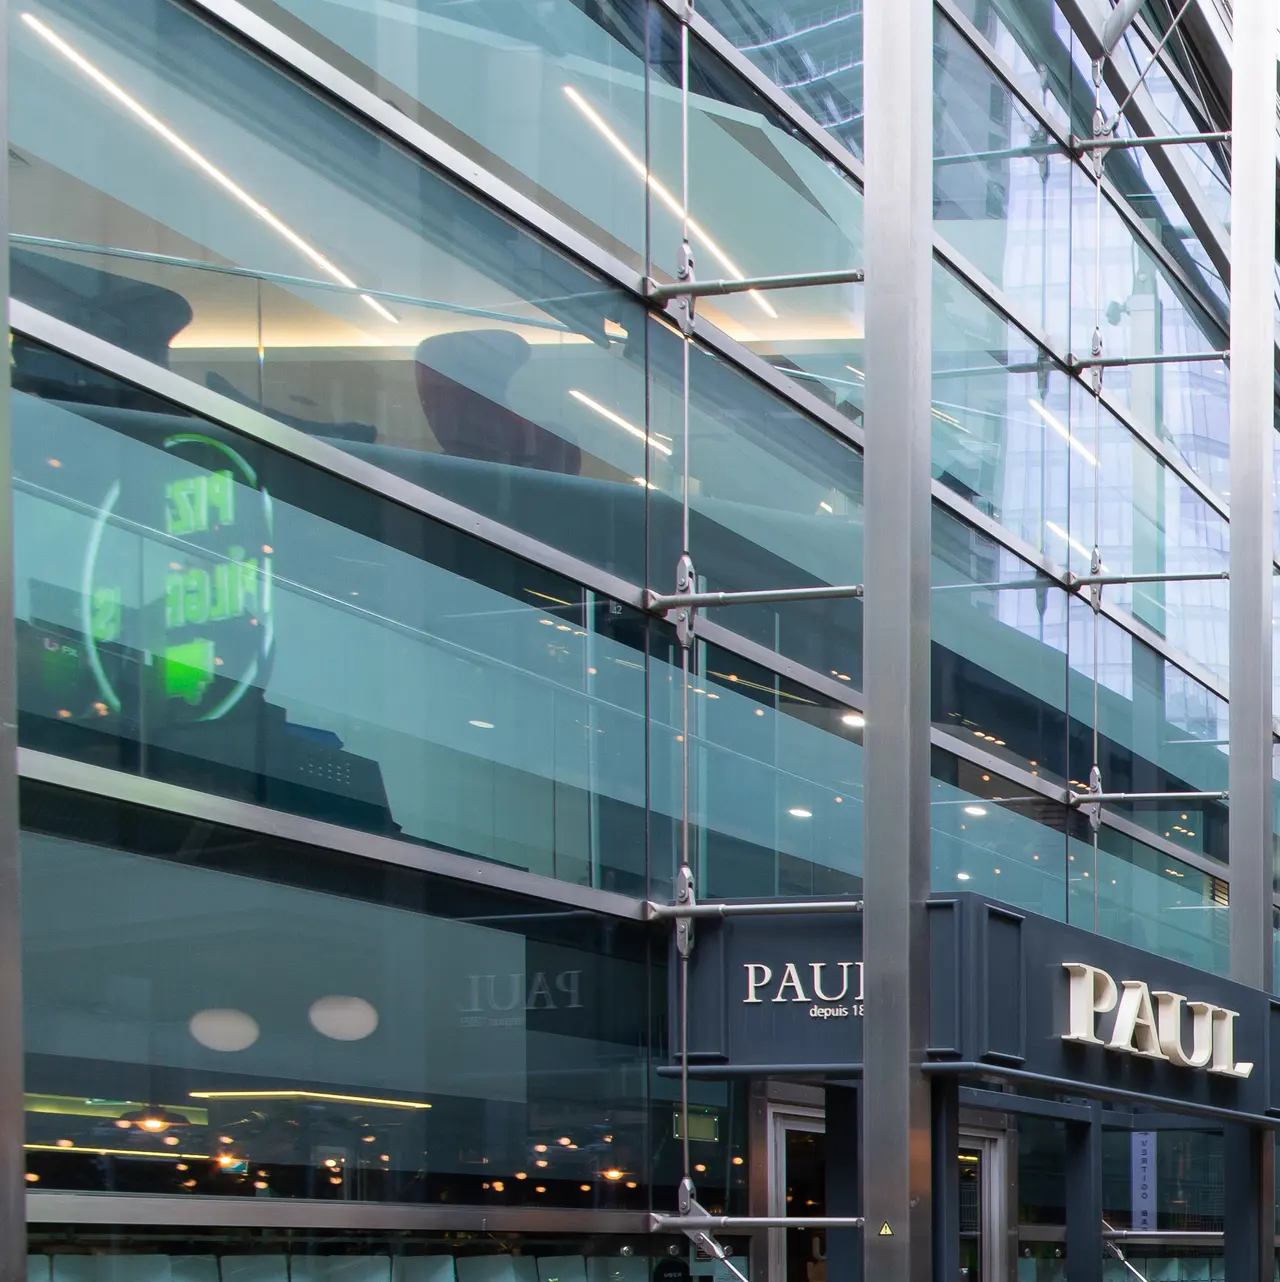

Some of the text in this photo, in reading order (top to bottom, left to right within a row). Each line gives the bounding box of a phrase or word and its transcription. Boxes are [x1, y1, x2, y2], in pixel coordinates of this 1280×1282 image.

[809, 1005, 864, 1019] depuis 18
[1061, 962, 1254, 1079] PAUL
